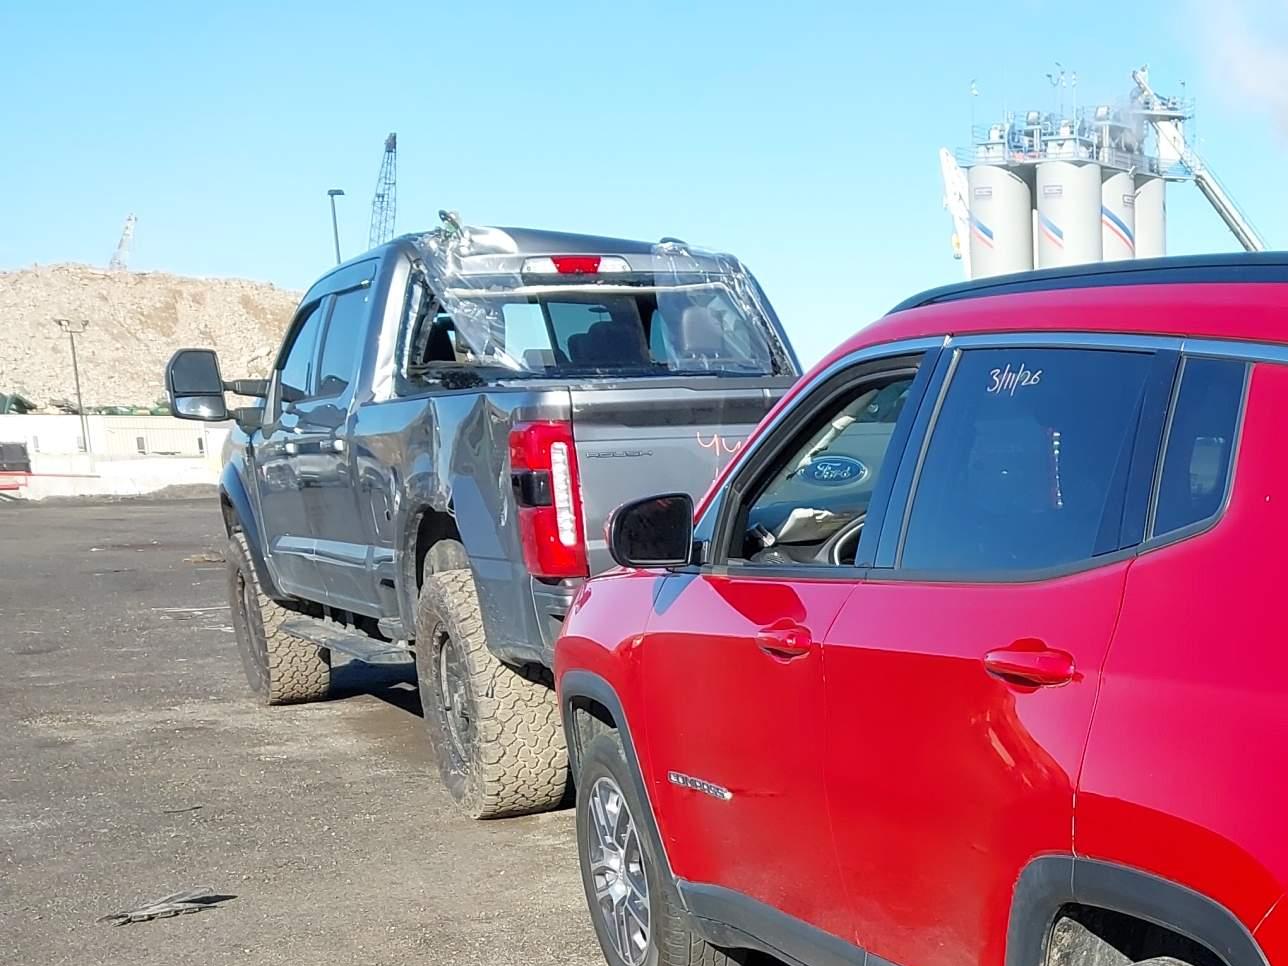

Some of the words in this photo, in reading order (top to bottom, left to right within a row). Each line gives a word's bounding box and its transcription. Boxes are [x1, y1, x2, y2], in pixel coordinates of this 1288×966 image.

[986, 363, 1043, 397] 3/11/26
[814, 462, 851, 480] Ford
[667, 770, 732, 801] COMPASS
